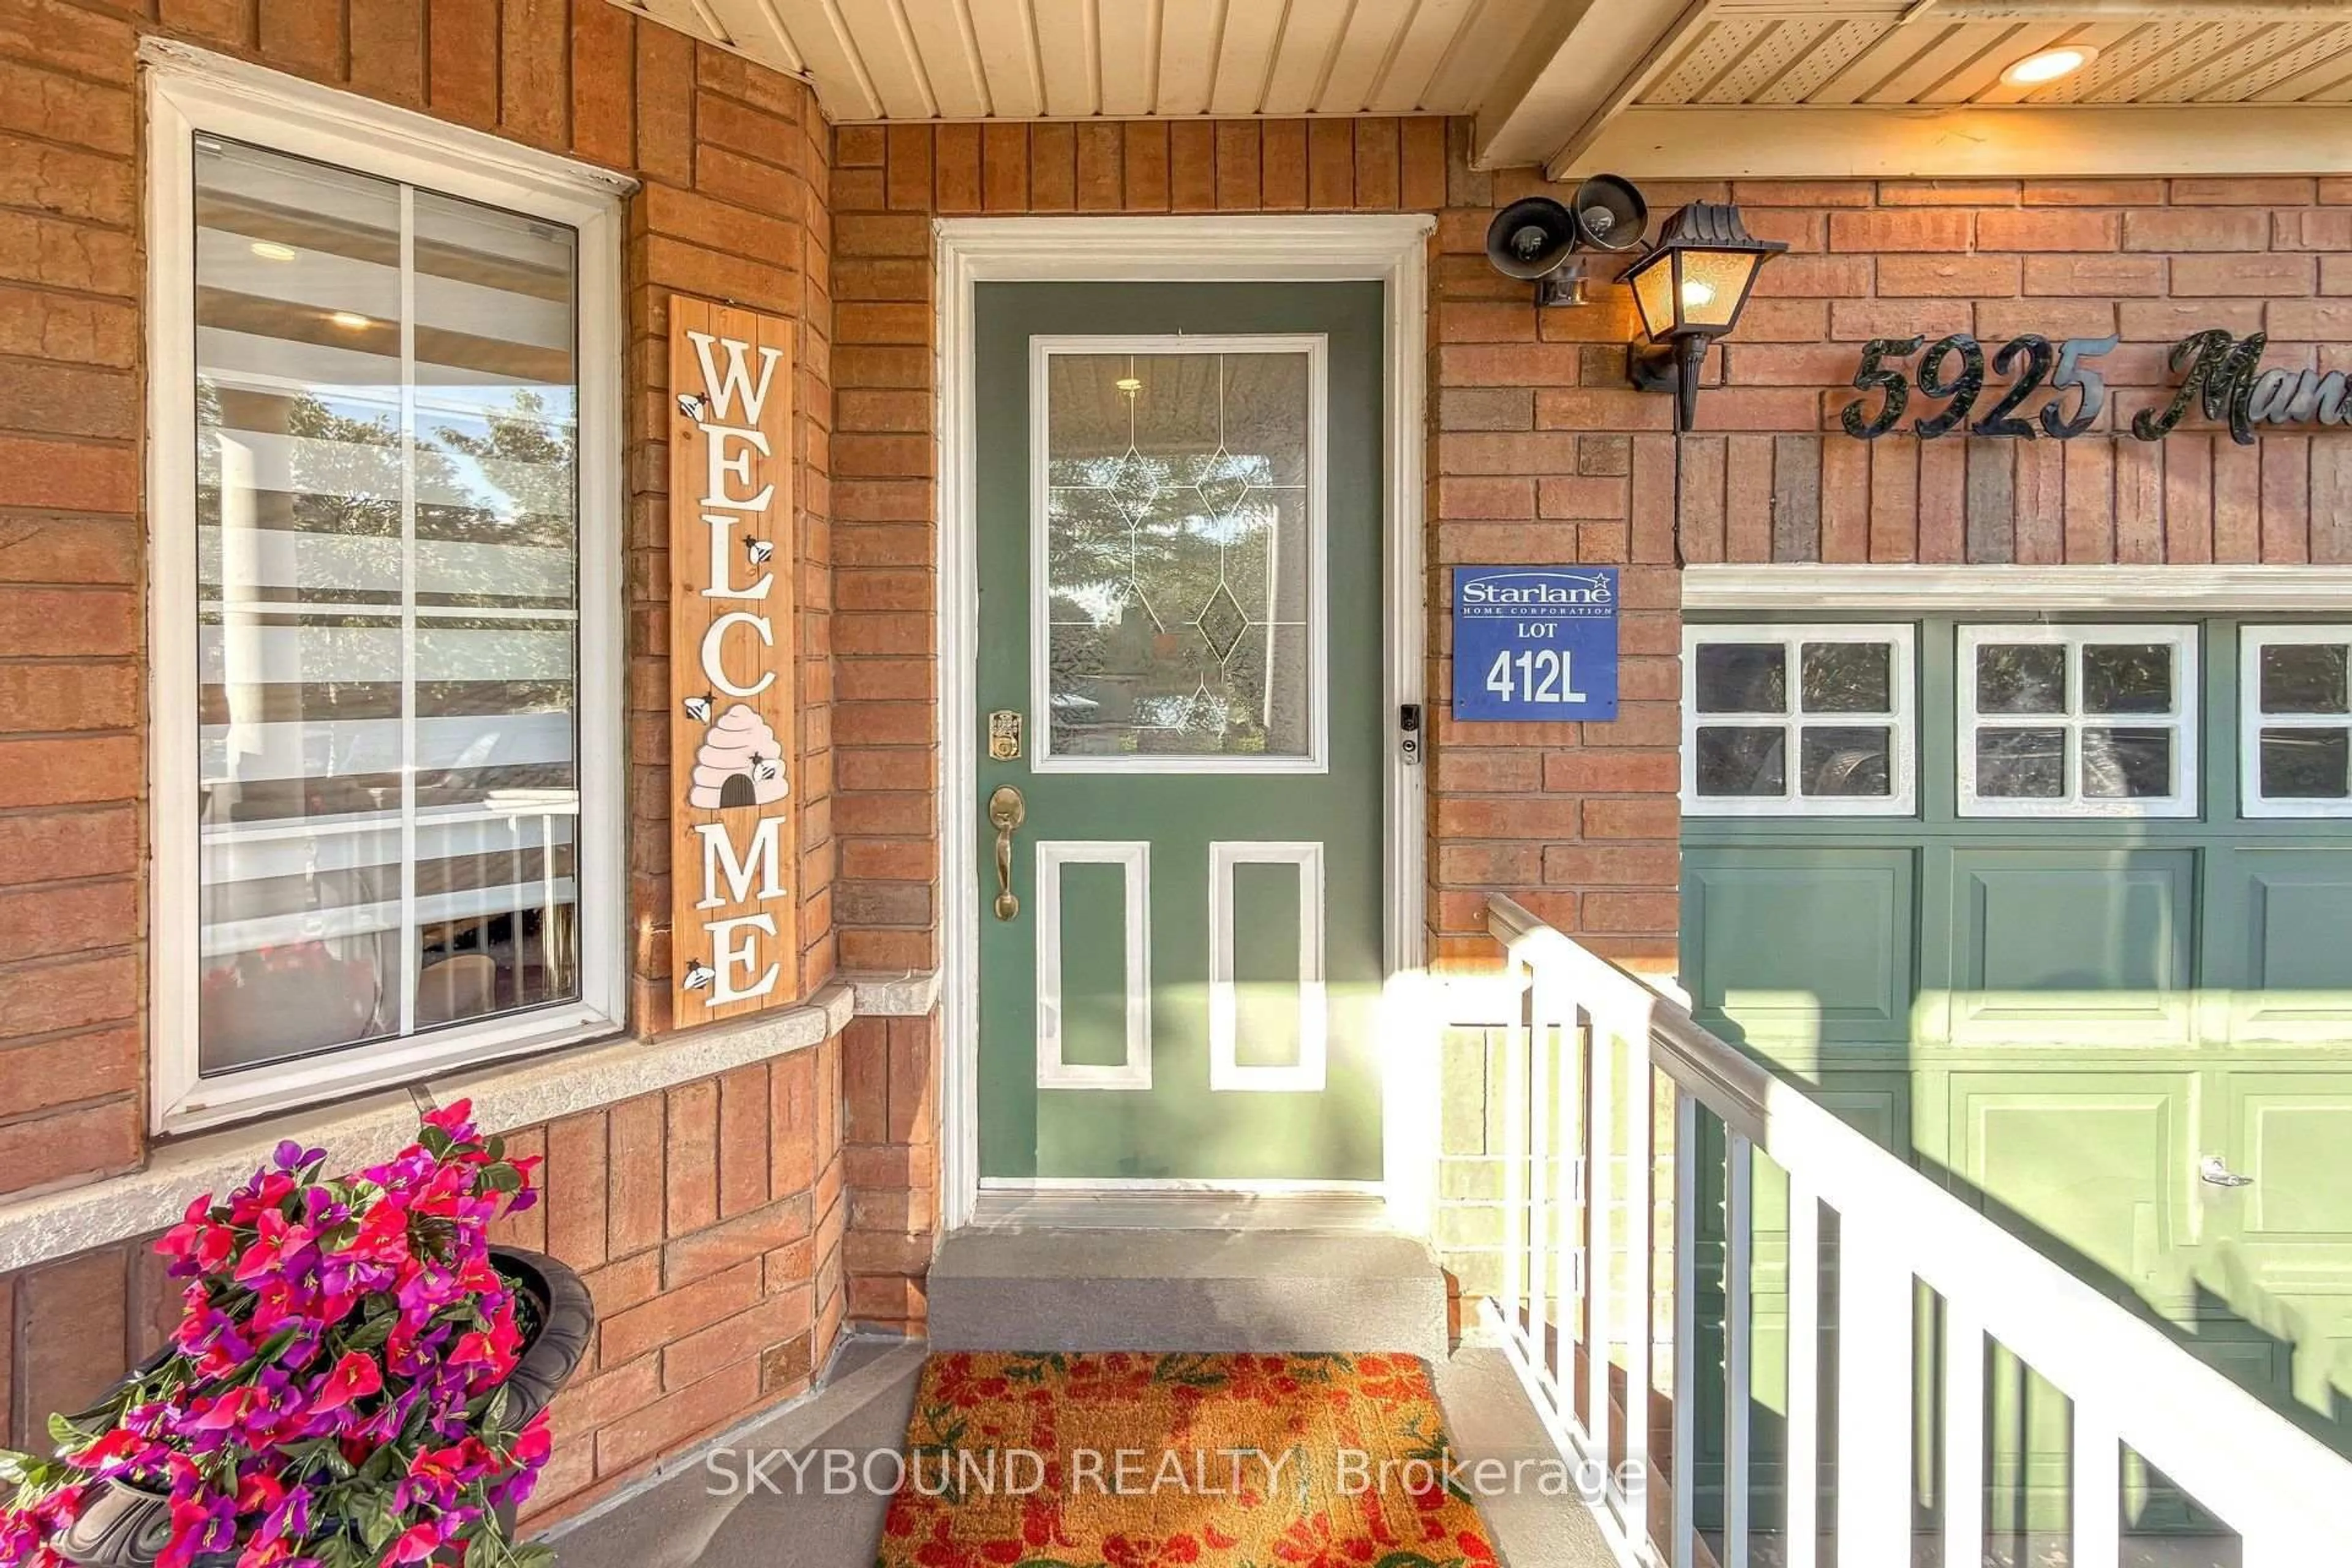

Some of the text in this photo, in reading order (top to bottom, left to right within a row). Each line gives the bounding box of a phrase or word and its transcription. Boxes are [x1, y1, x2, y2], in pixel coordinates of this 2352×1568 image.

[1841, 328, 2352, 446] 5925 Man
[1463, 582, 1611, 603] Starlane
[1518, 623, 1558, 638] LOT
[687, 330, 789, 1007] WELCME
[1486, 649, 1586, 703] 412L
